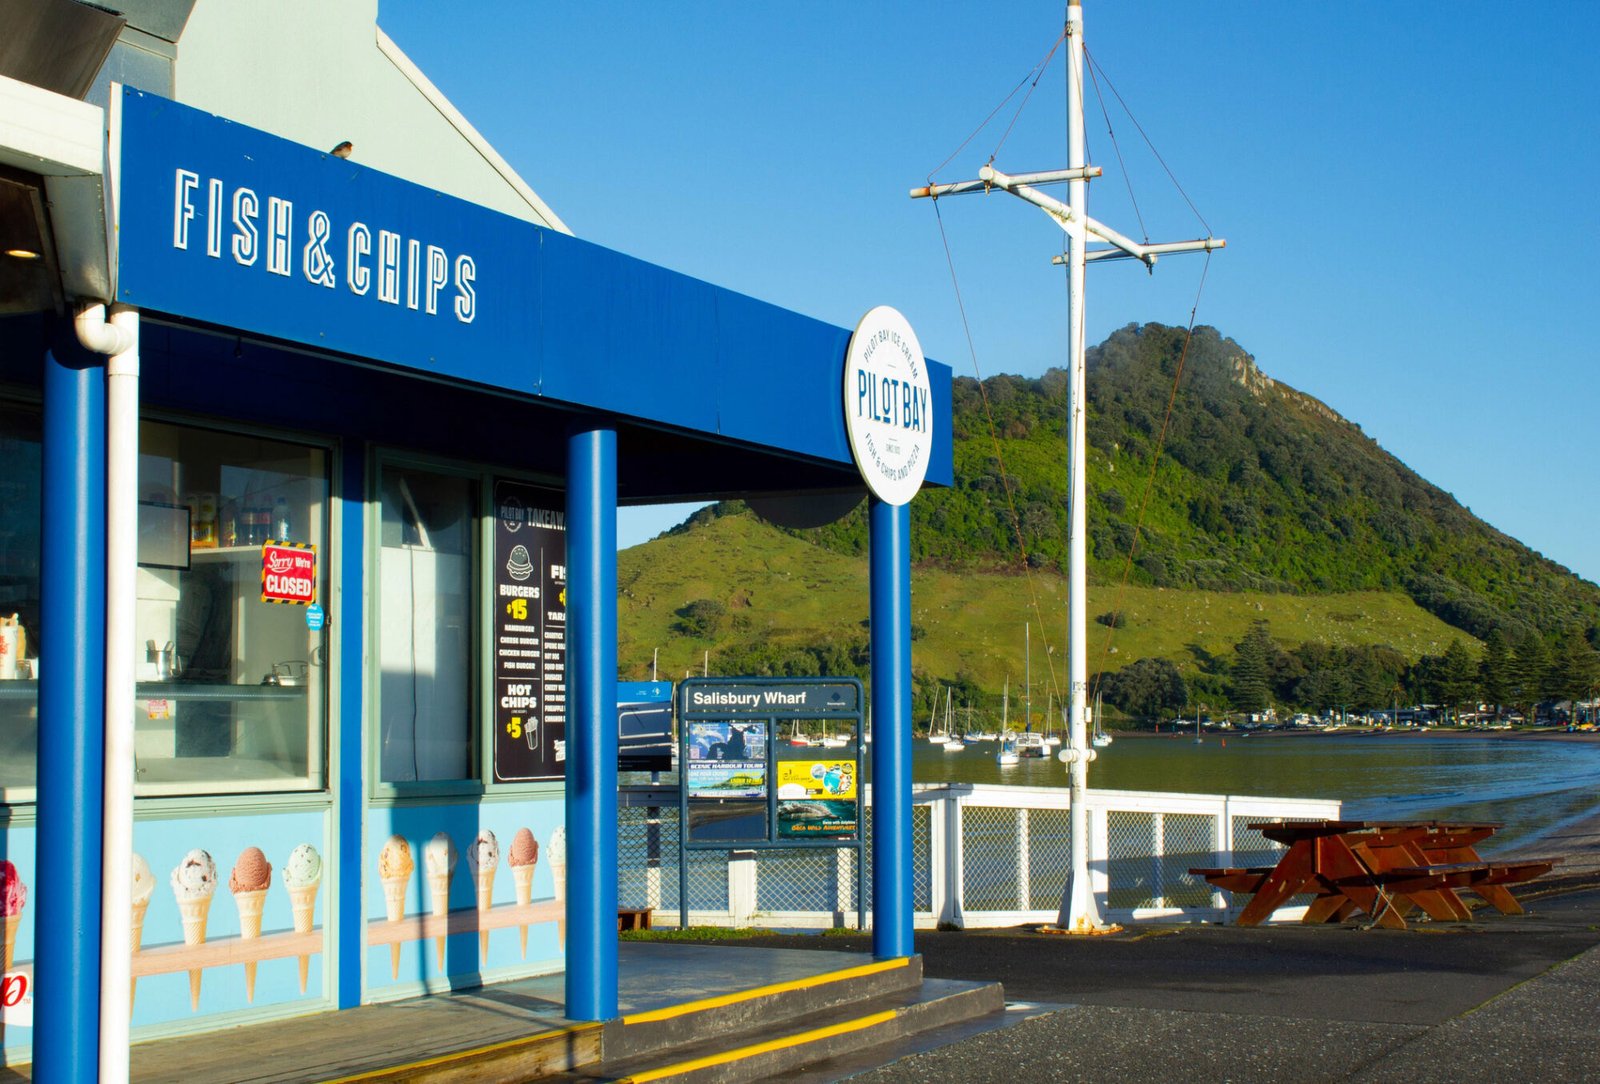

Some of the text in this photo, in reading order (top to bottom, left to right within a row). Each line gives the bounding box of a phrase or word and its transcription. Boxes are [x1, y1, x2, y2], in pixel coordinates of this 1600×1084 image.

[173, 168, 476, 324] FISH & CHIPS
[864, 329, 918, 379] PILOT BAY ICE CREAM
[858, 369, 927, 434] PILOT BAY
[865, 432, 877, 459] FISH
[881, 462, 897, 481] CHIPS
[898, 465, 908, 480] AND
[907, 444, 920, 471] PIZZA
[267, 551, 294, 573] Sorry
[266, 575, 312, 597] CLOSED
[500, 584, 540, 599] BURGERS
[506, 598, 527, 621] $15
[508, 684, 532, 696] HOT
[693, 691, 807, 707] Salisbury Wharf
[501, 697, 537, 709] CHIPS
[506, 717, 521, 739] $5
